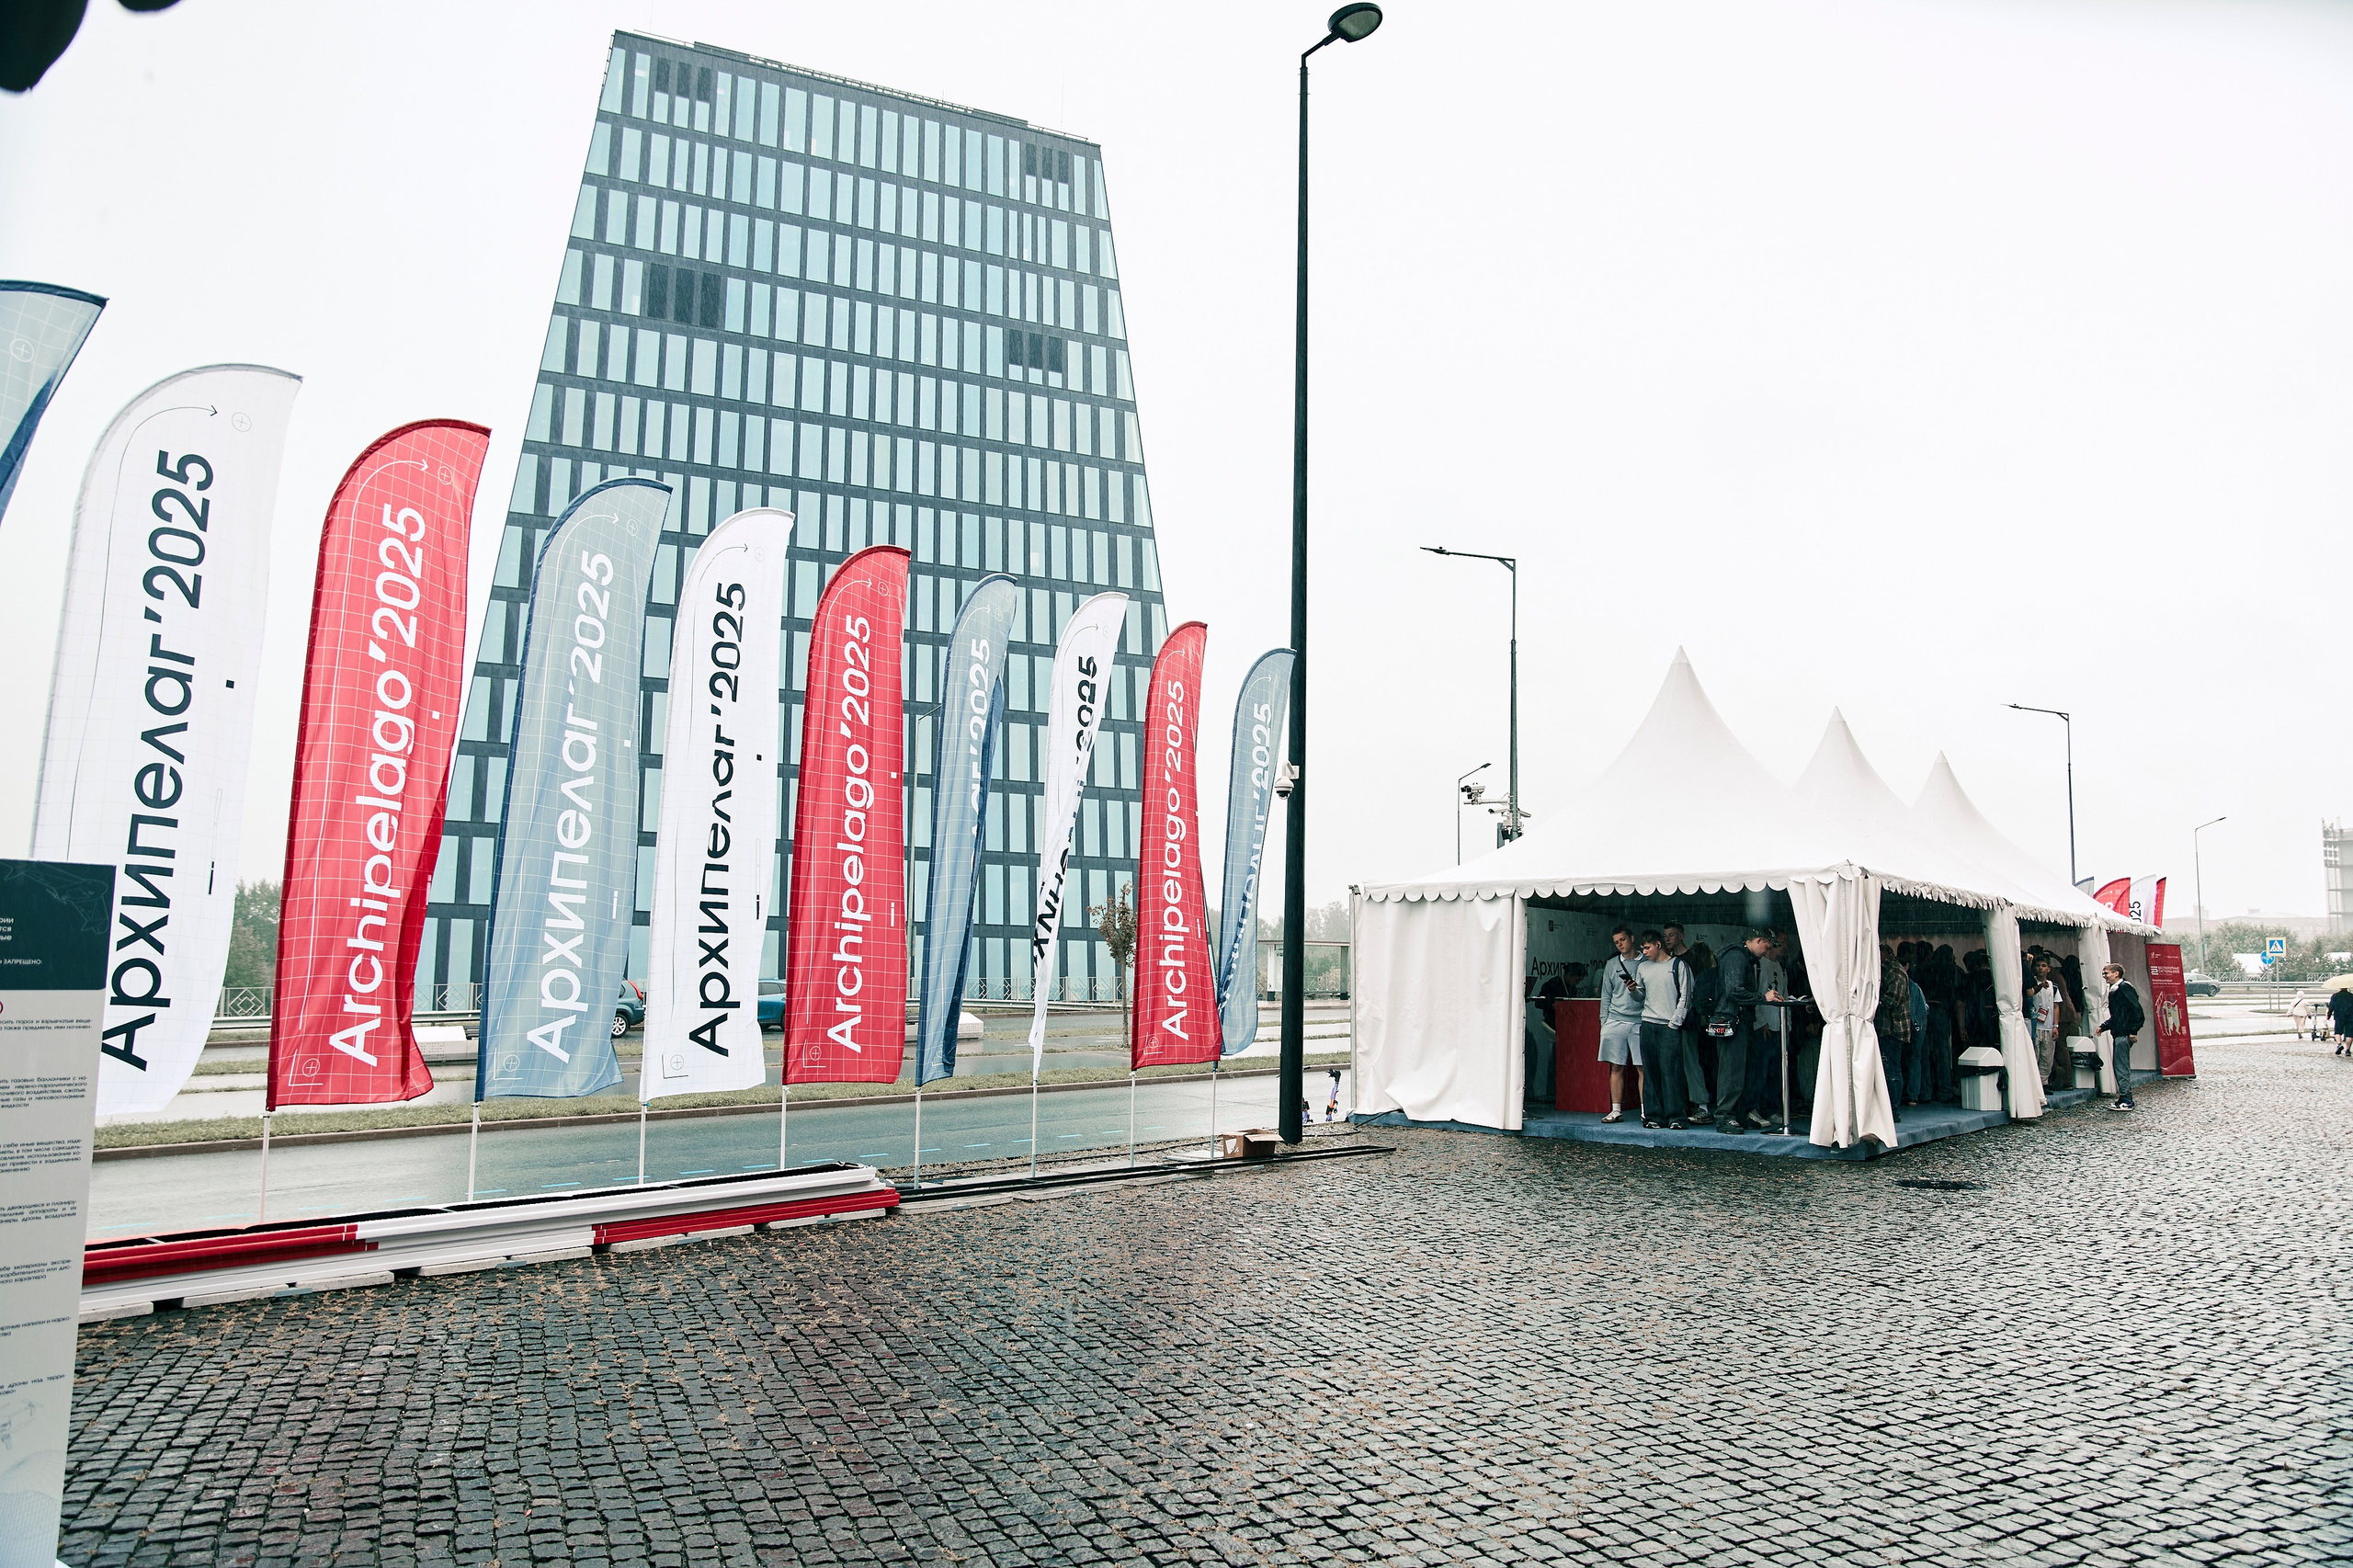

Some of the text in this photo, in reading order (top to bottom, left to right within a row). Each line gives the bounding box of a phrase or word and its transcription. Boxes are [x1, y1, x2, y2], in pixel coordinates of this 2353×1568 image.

[328, 503, 426, 1068] Archipelago'2025
[527, 551, 614, 1062] Архипелаг'2025
[688, 582, 746, 1058] Архипелаг'2025
[826, 614, 872, 1053] Archipelago'2025
